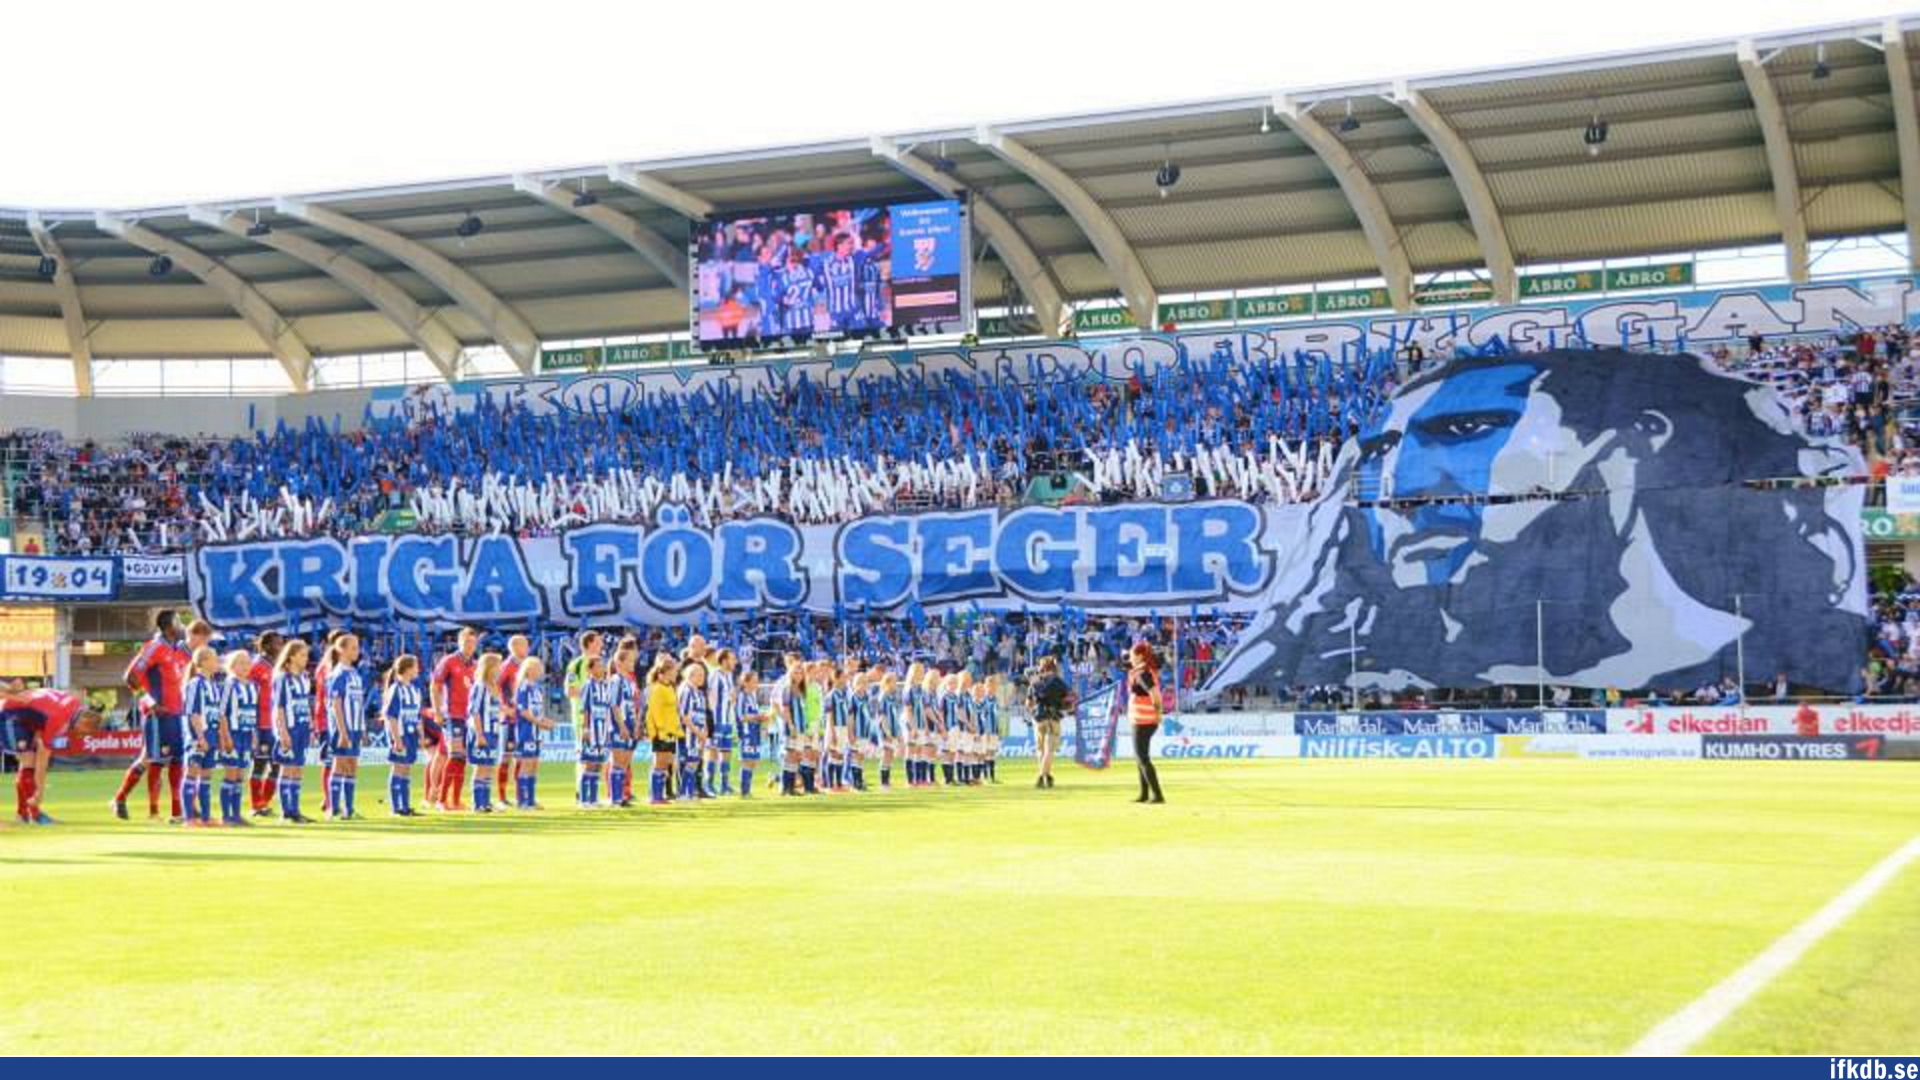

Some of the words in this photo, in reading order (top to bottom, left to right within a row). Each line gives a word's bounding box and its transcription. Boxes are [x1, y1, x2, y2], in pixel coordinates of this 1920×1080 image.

[200, 534, 542, 631] KRIGA
[561, 500, 812, 617] FÖR
[833, 499, 1279, 608] SEGER
[1667, 711, 1768, 736] elkedjan
[83, 735, 121, 752] Spela
[1307, 737, 1487, 758] Nilfisk-ALTO
[1705, 742, 1781, 759] KUMHO
[1783, 742, 1848, 759] TYRES
